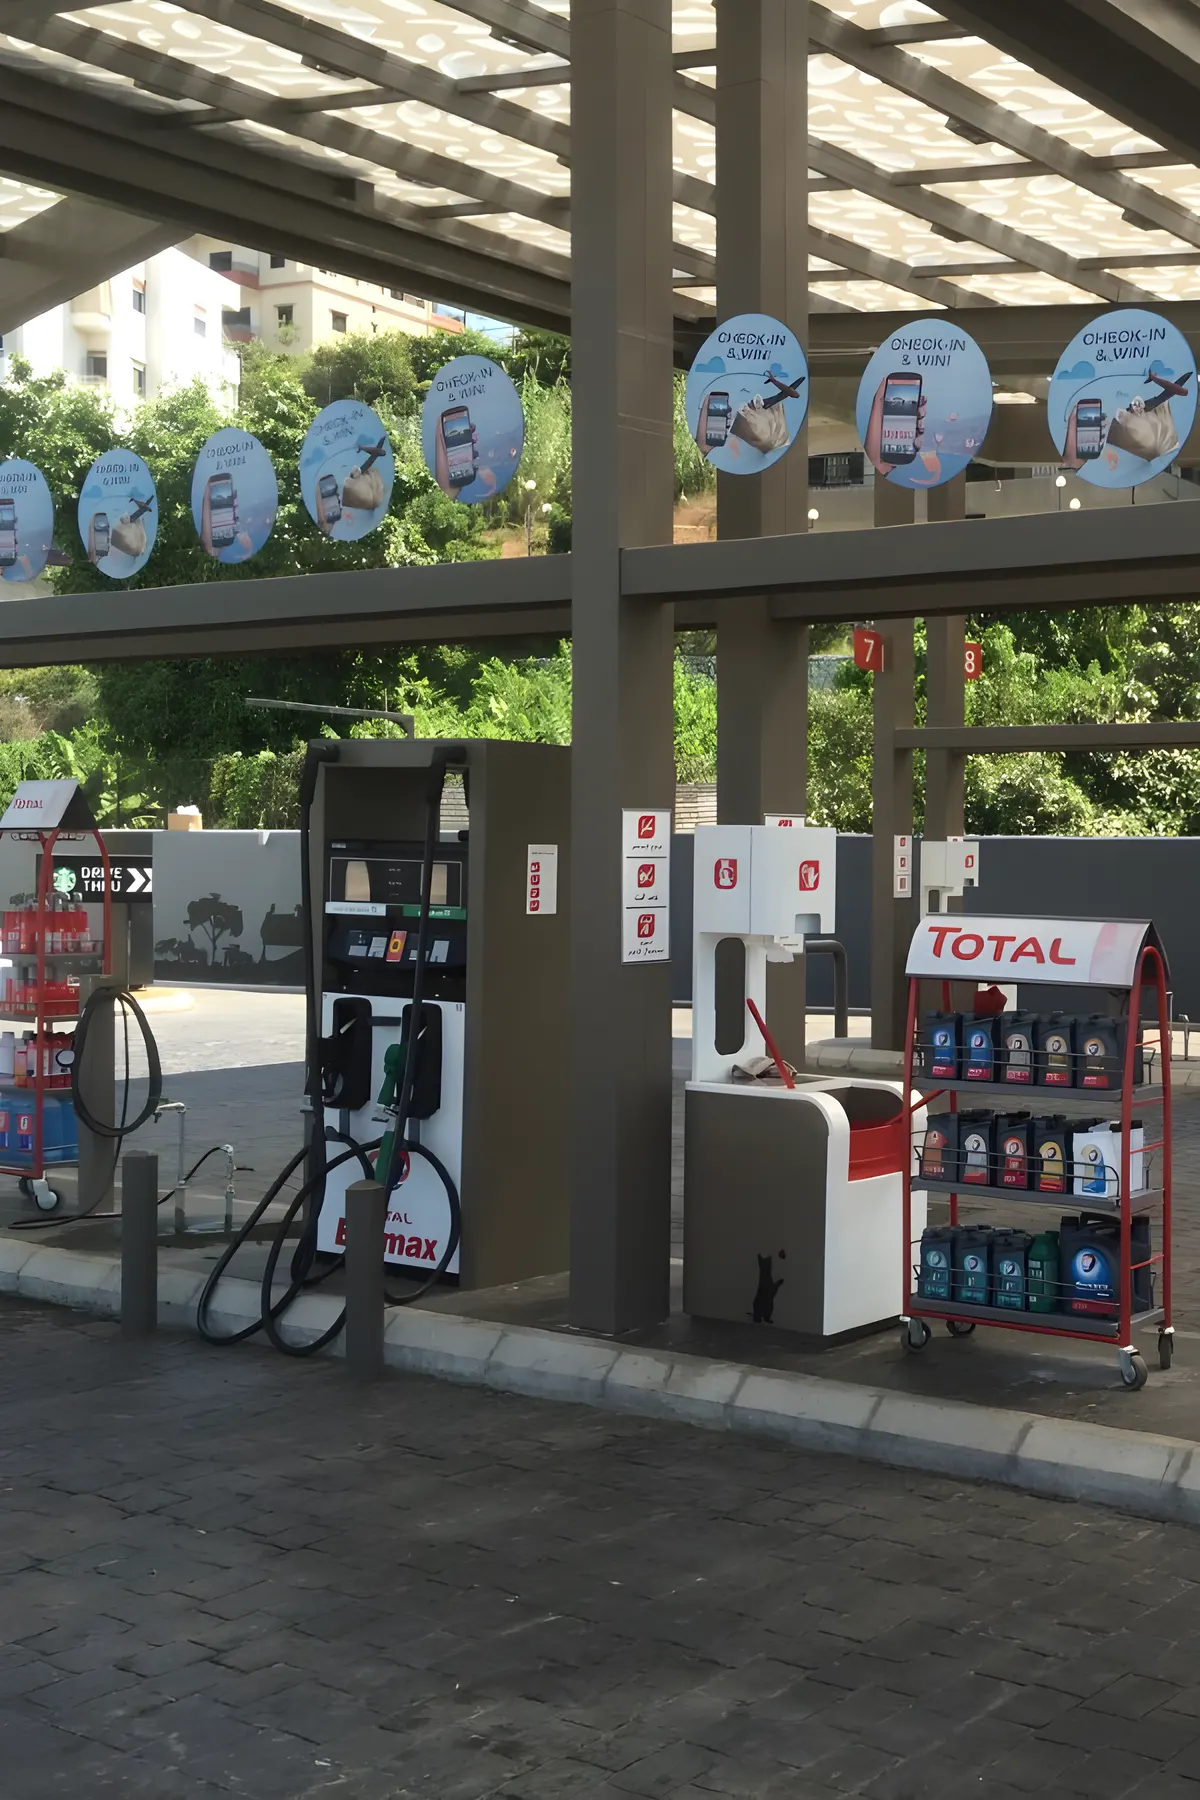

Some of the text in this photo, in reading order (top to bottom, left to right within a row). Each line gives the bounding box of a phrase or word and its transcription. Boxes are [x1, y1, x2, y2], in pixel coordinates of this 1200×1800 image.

[864, 638, 875, 662] 7
[964, 650, 975, 673] 8
[928, 926, 1077, 965] TOTAL
[386, 1210, 413, 1225] TAL
[335, 1217, 438, 1261] Emax
